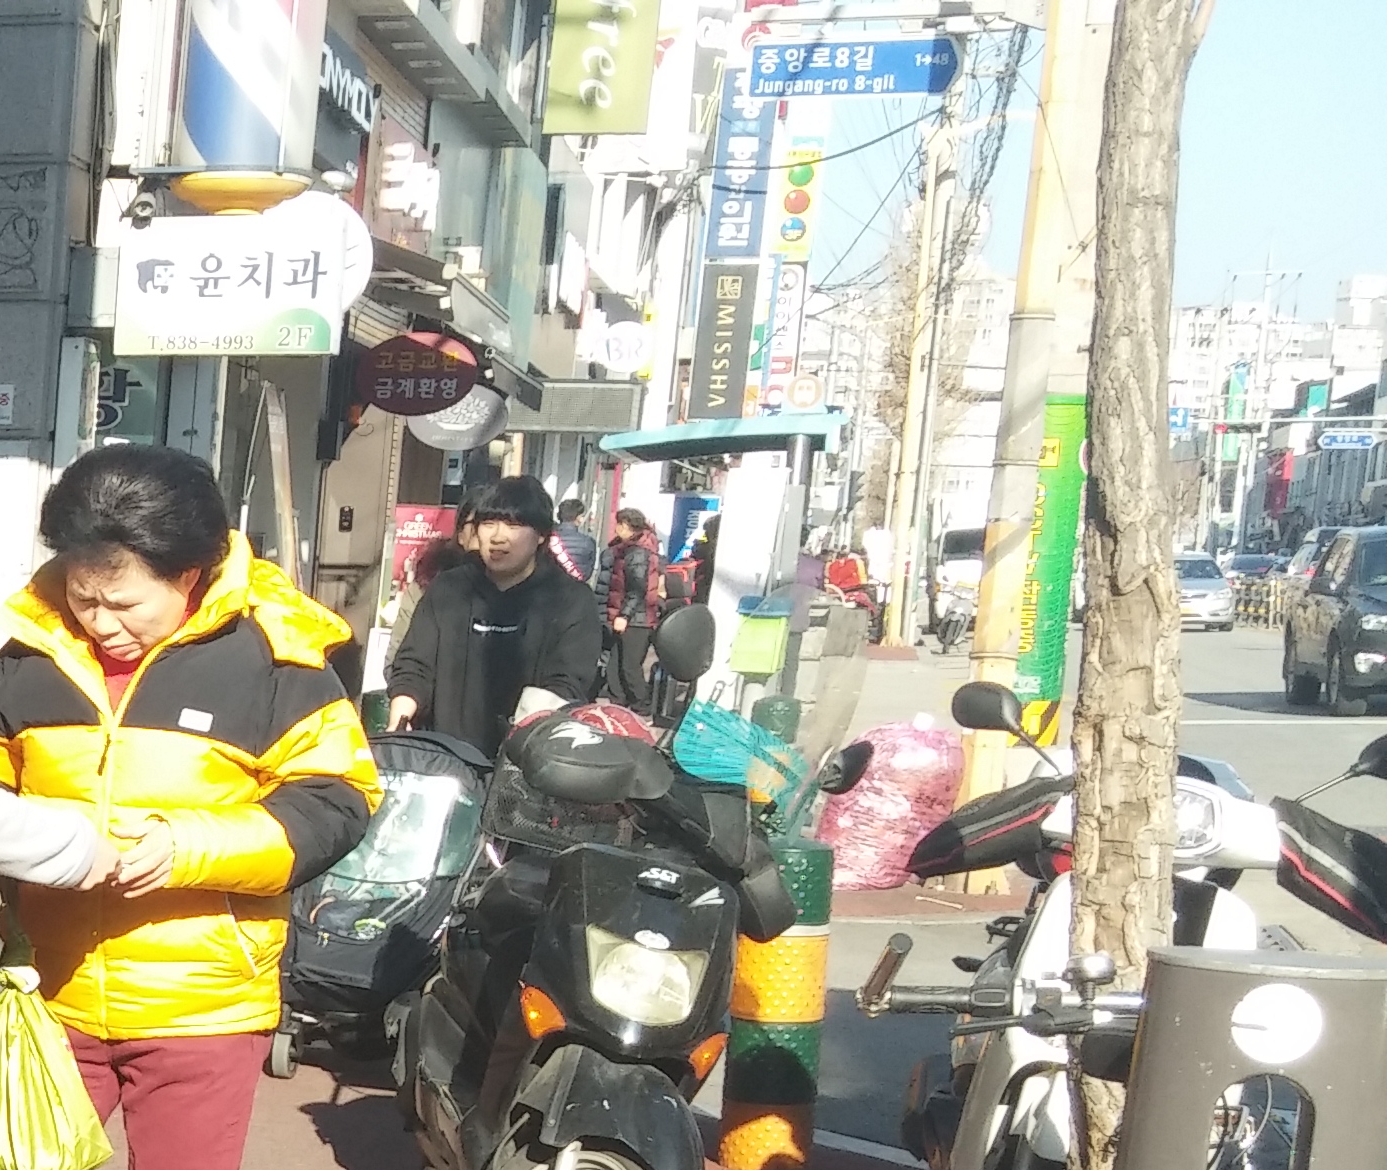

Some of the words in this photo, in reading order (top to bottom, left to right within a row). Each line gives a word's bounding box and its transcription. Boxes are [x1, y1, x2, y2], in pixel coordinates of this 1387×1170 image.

[757, 45, 875, 73] 중앙로8길
[755, 77, 848, 95] Jungang-ro
[854, 74, 895, 93] 8-gil
[189, 250, 328, 300] 윤치과
[278, 326, 313, 347] 2F
